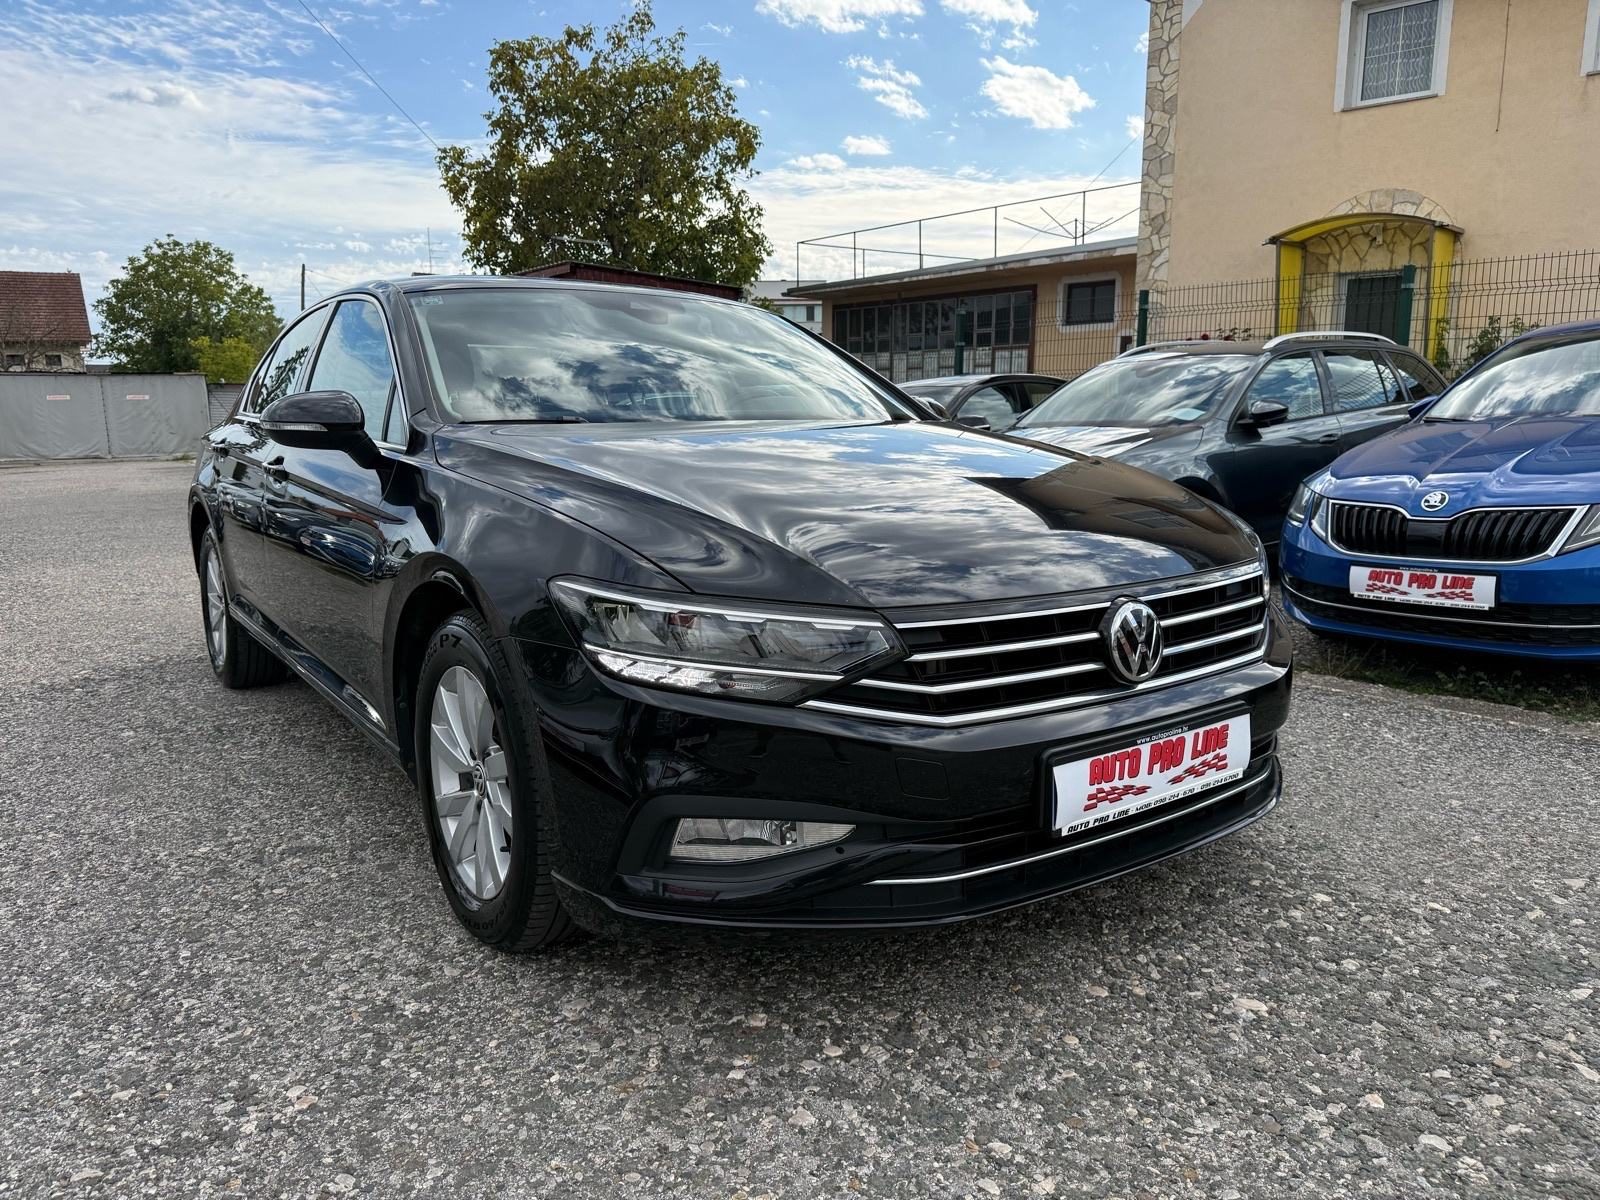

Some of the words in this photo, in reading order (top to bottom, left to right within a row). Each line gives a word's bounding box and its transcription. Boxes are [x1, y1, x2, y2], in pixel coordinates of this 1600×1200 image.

[1368, 569, 1404, 586] AUTO
[1407, 573, 1437, 590] PRO
[1441, 575, 1475, 590] LINE
[439, 633, 463, 649] P7
[1111, 602, 1162, 681] VW
[1136, 726, 1189, 744] www.autoproline.hr
[1089, 748, 1142, 786] AUTO
[1147, 735, 1187, 775] PRO
[1190, 724, 1230, 760] LINE
[1067, 821, 1091, 834] AUTO
[1093, 814, 1110, 826] PRO
[1112, 808, 1130, 819] LINE
